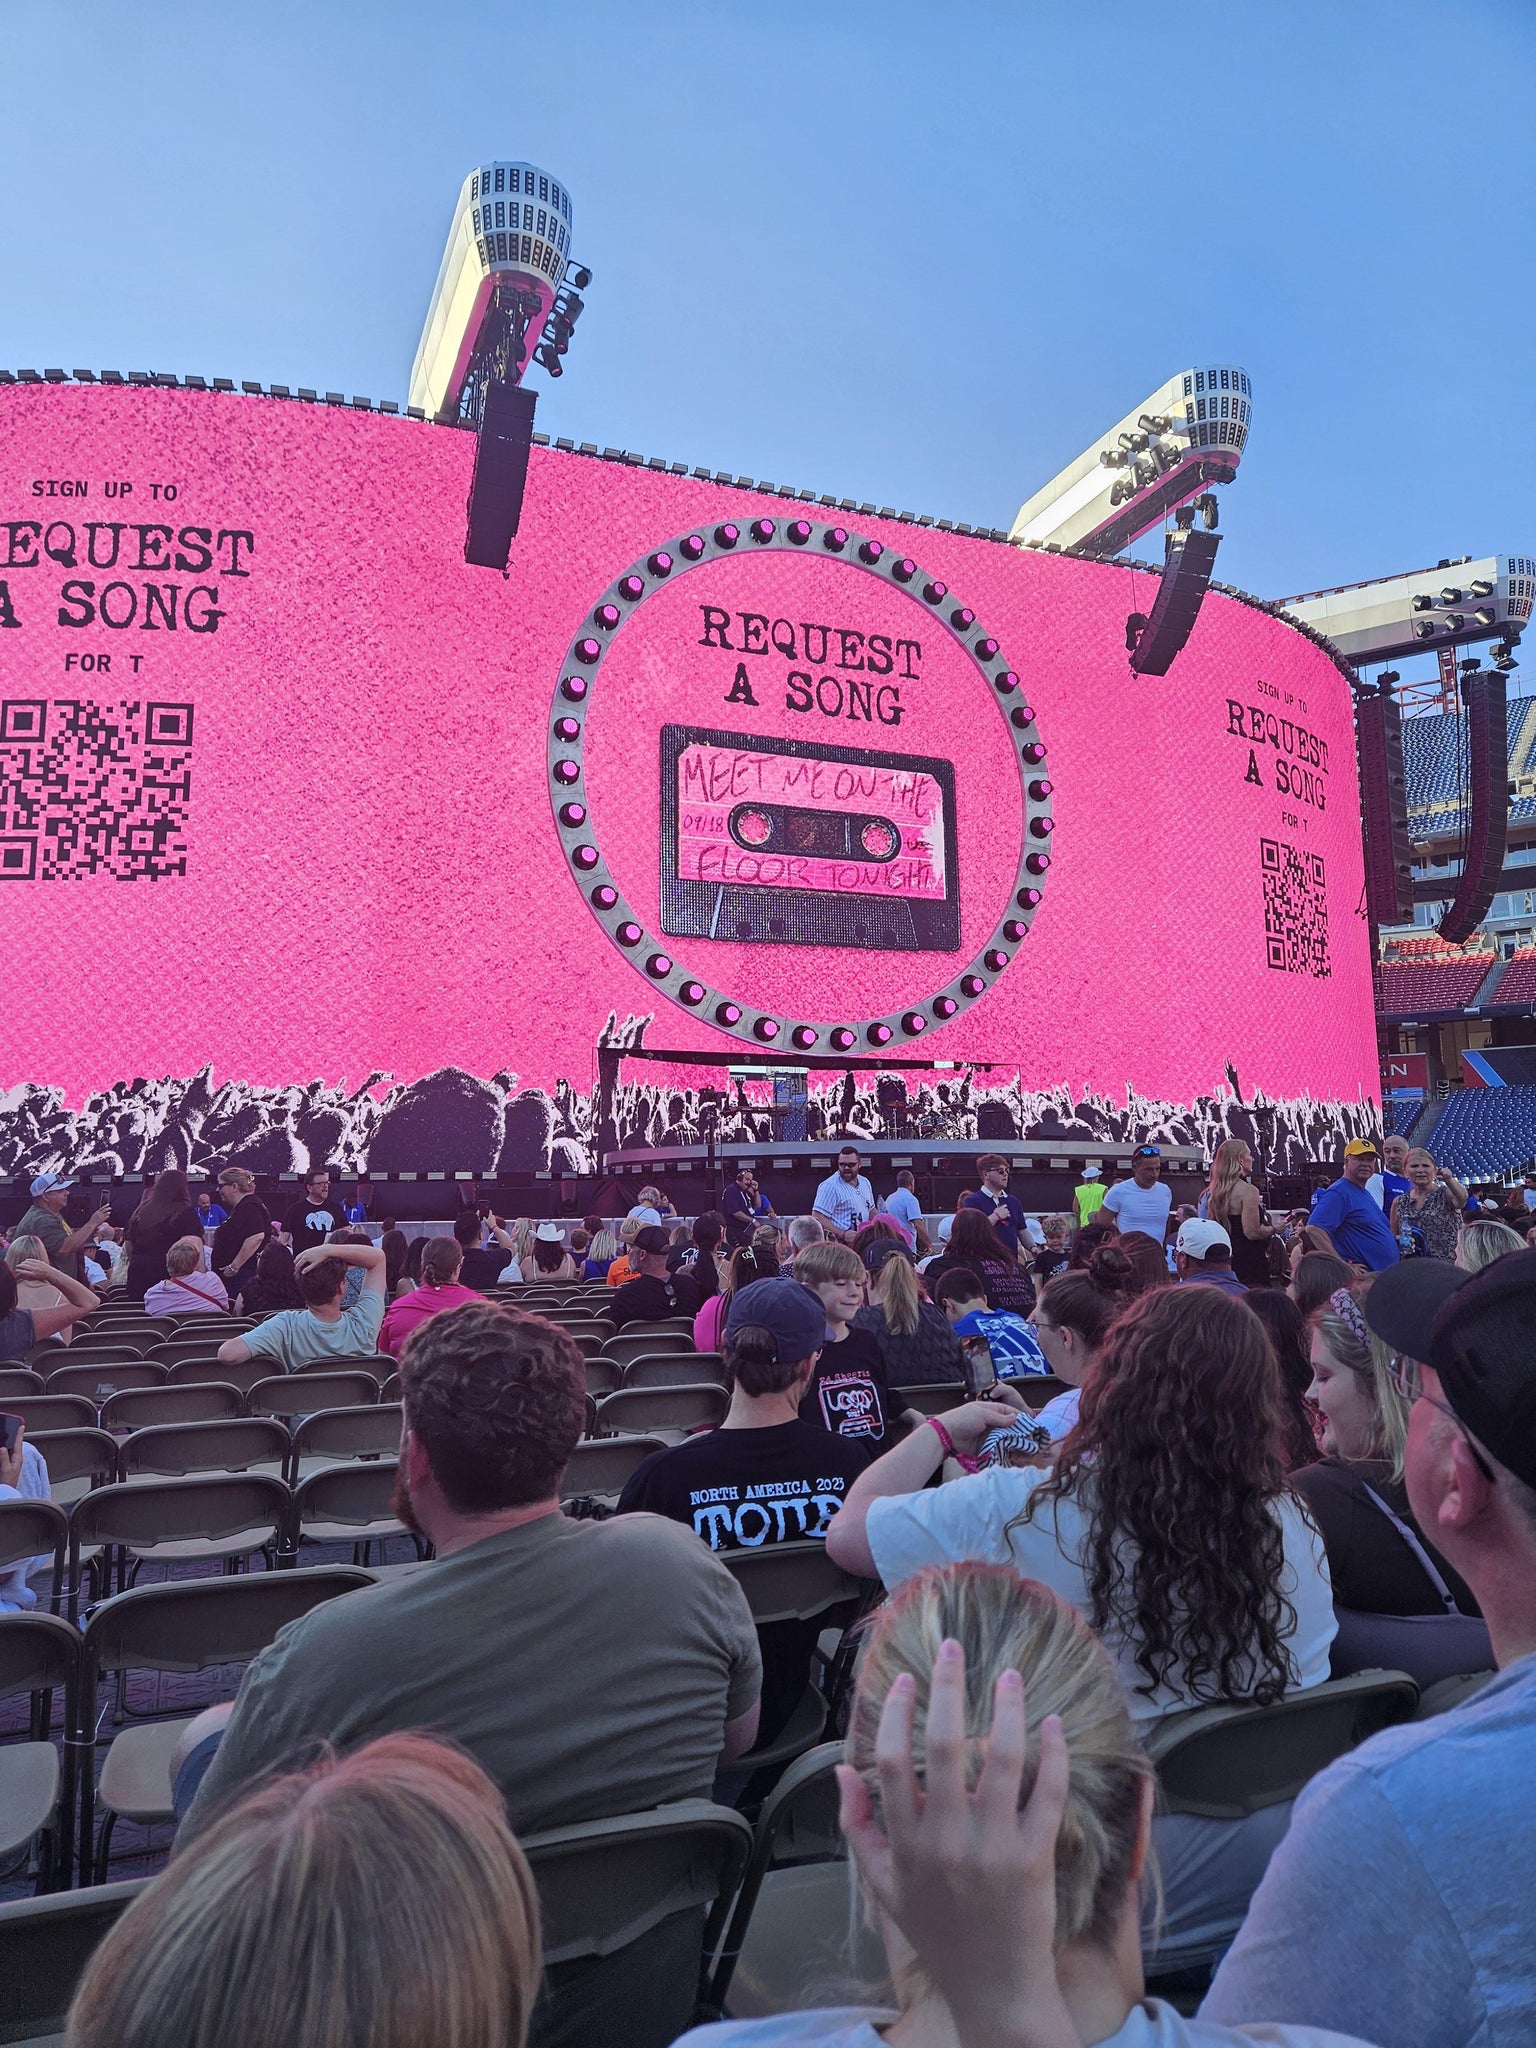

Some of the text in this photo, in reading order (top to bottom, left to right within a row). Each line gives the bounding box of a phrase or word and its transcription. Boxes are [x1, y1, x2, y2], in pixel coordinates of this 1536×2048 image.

[32, 480, 178, 500] SIGN UP TO
[0, 521, 254, 577] EQUEST
[58, 580, 227, 633] SONG
[65, 653, 144, 673] FOR T
[698, 605, 922, 680] REQUEST
[724, 663, 906, 725] A SONG
[1257, 680, 1307, 713] SIGN UP TO
[1226, 698, 1329, 775] REQUEST
[684, 753, 931, 818] MEET ME ON THE
[1244, 749, 1326, 810] A SONG
[1282, 811, 1308, 832] FOR T
[697, 846, 932, 890] FLOOR TONIGHT
[689, 1477, 845, 1506] NORTH AMERICA 2023
